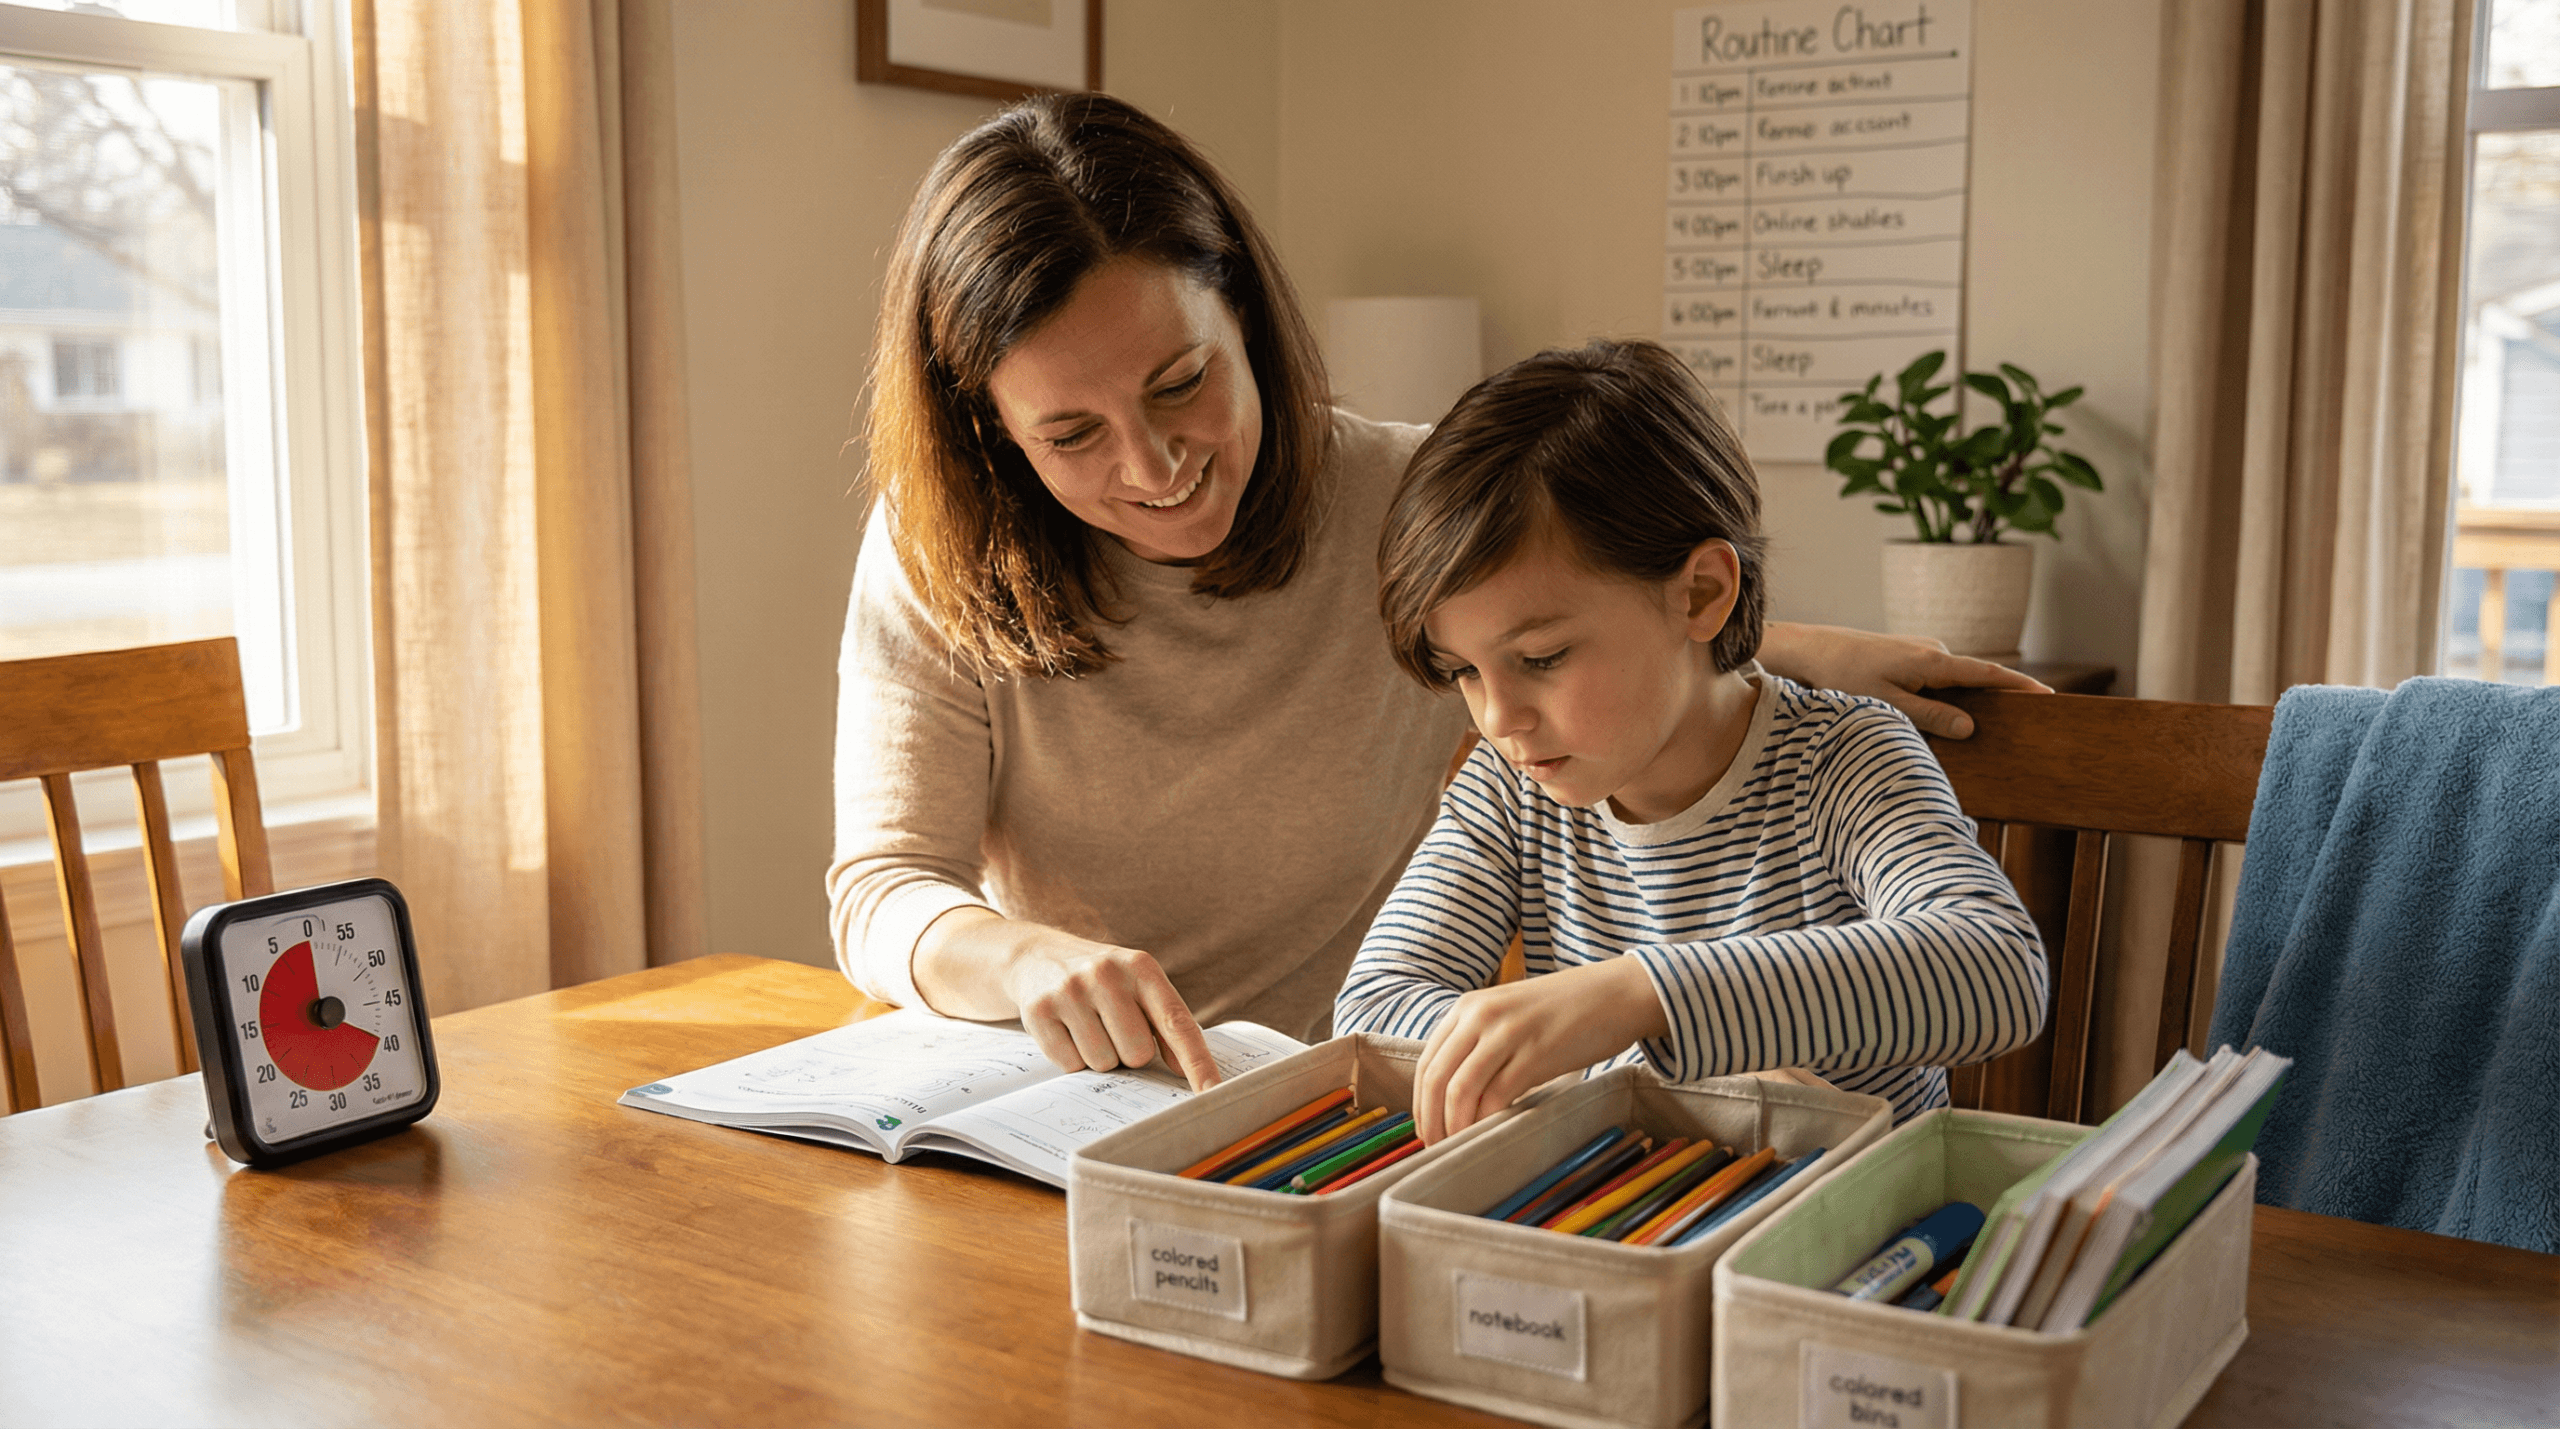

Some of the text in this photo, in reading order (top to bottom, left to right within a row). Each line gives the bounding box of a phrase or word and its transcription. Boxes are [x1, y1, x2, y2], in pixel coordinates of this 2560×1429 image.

[1701, 3, 1934, 63] Routine Chart
[1822, 164, 1852, 192] up
[1756, 250, 1823, 284] Sleep
[1752, 344, 1813, 376] Sleep
[303, 919, 313, 937] 0
[336, 922, 355, 941] 55
[267, 937, 279, 954] 5
[368, 949, 386, 968] 50
[242, 974, 260, 993] 10
[385, 988, 401, 1007] 45
[240, 1020, 259, 1039] 15
[383, 1034, 400, 1052] 40
[256, 1063, 276, 1084] 20
[363, 1073, 381, 1093] 35
[289, 1090, 308, 1109] 25
[329, 1092, 347, 1112] 30
[1150, 1246, 1219, 1273] colored
[1469, 1309, 1566, 1341] notebook
[1828, 1374, 1924, 1411] colored
[1848, 1401, 1900, 1429] bins
